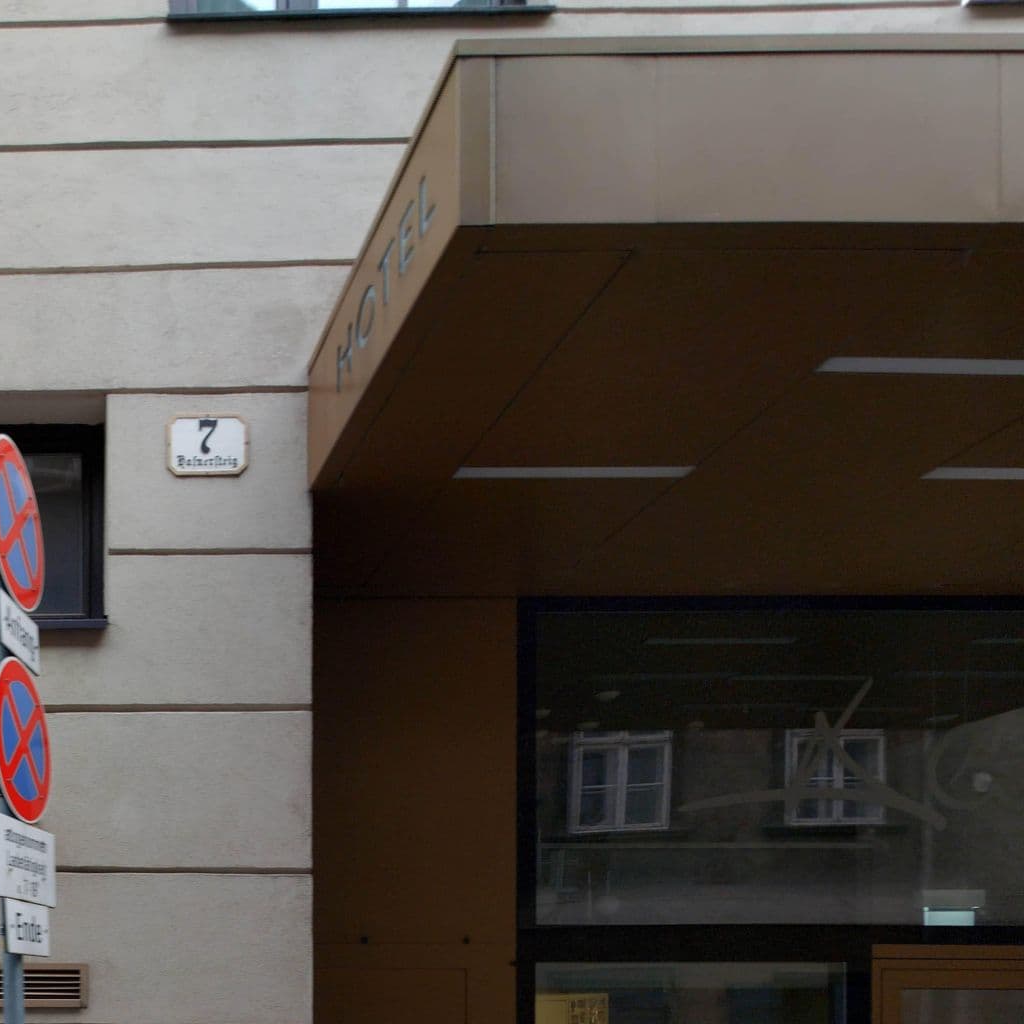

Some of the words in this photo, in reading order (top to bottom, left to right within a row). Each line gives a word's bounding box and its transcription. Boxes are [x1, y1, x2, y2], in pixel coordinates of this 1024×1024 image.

[336, 175, 436, 393] HOTEL
[198, 419, 218, 454] 7
[16, 912, 42, 943] Ende
